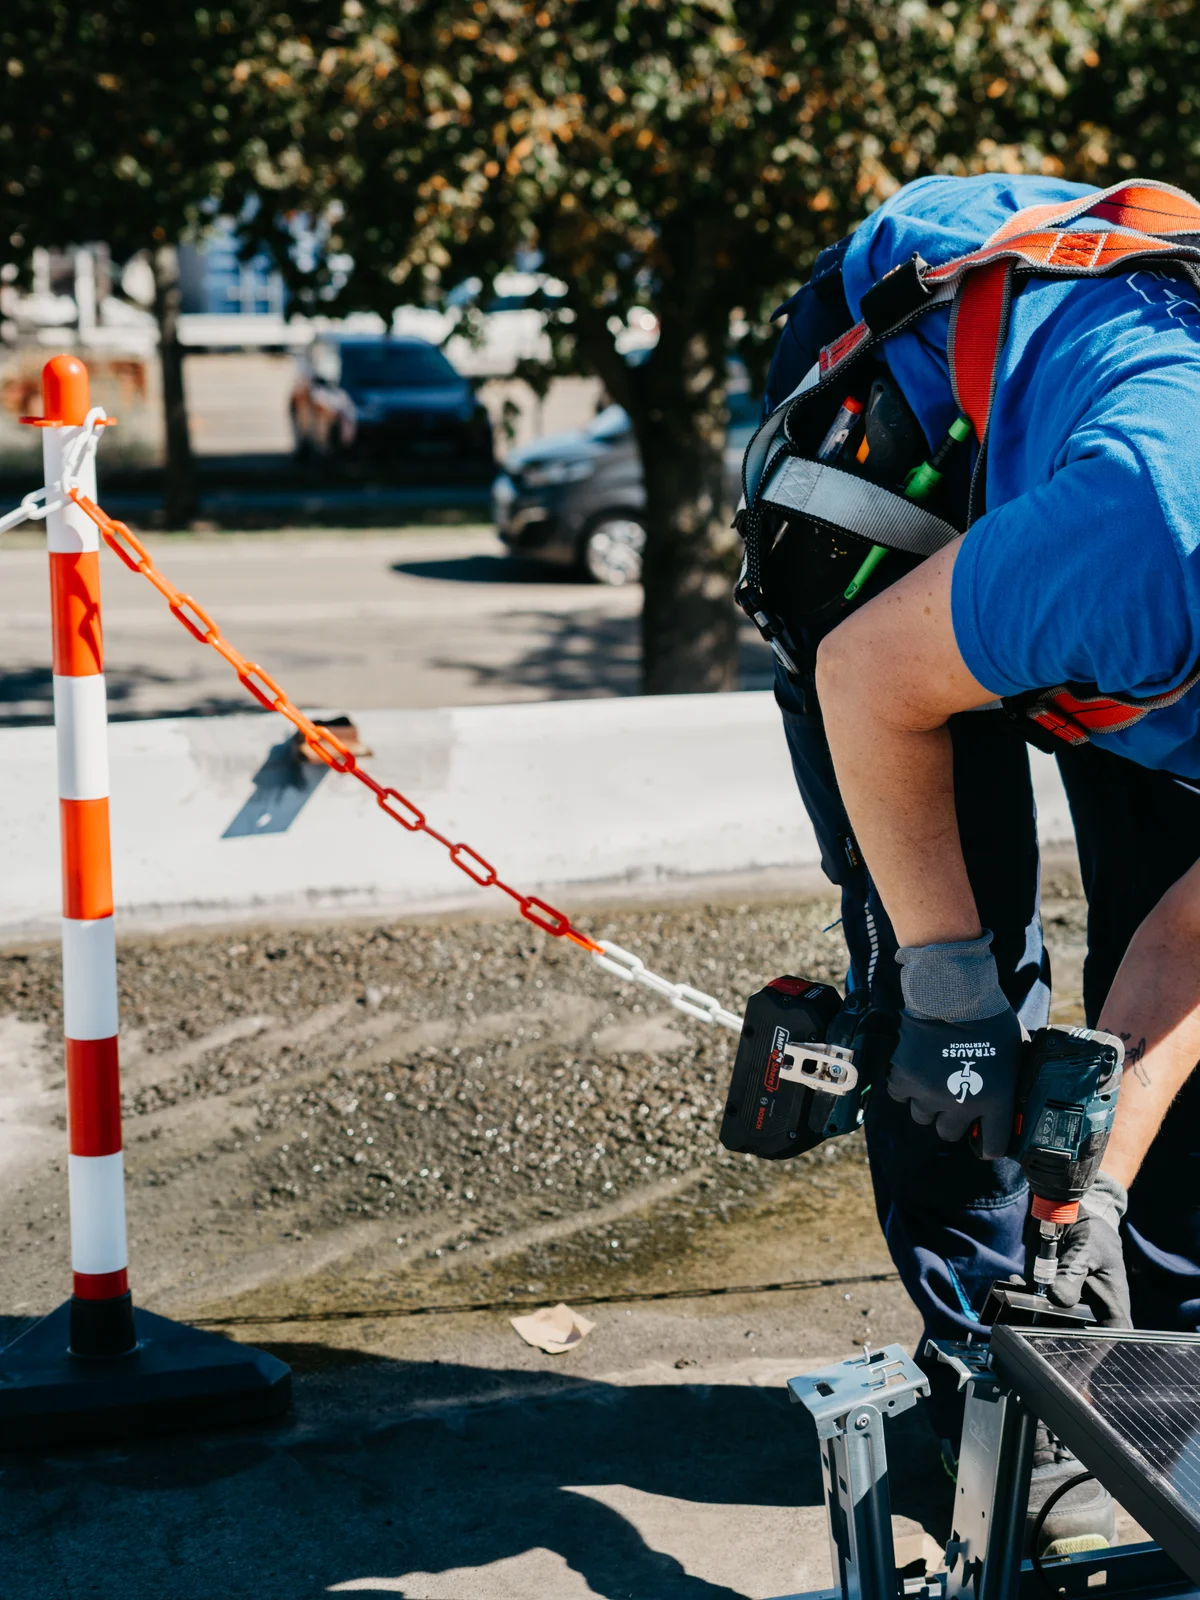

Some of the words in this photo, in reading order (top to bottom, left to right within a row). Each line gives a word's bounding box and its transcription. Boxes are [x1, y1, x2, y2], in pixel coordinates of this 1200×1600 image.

[775, 1029, 786, 1051] AMP
[950, 1041, 990, 1049] EVERTOUCH
[942, 1047, 997, 1058] STRAUSS
[767, 1062, 779, 1086] Share
[756, 1106, 766, 1130] BOSCH
